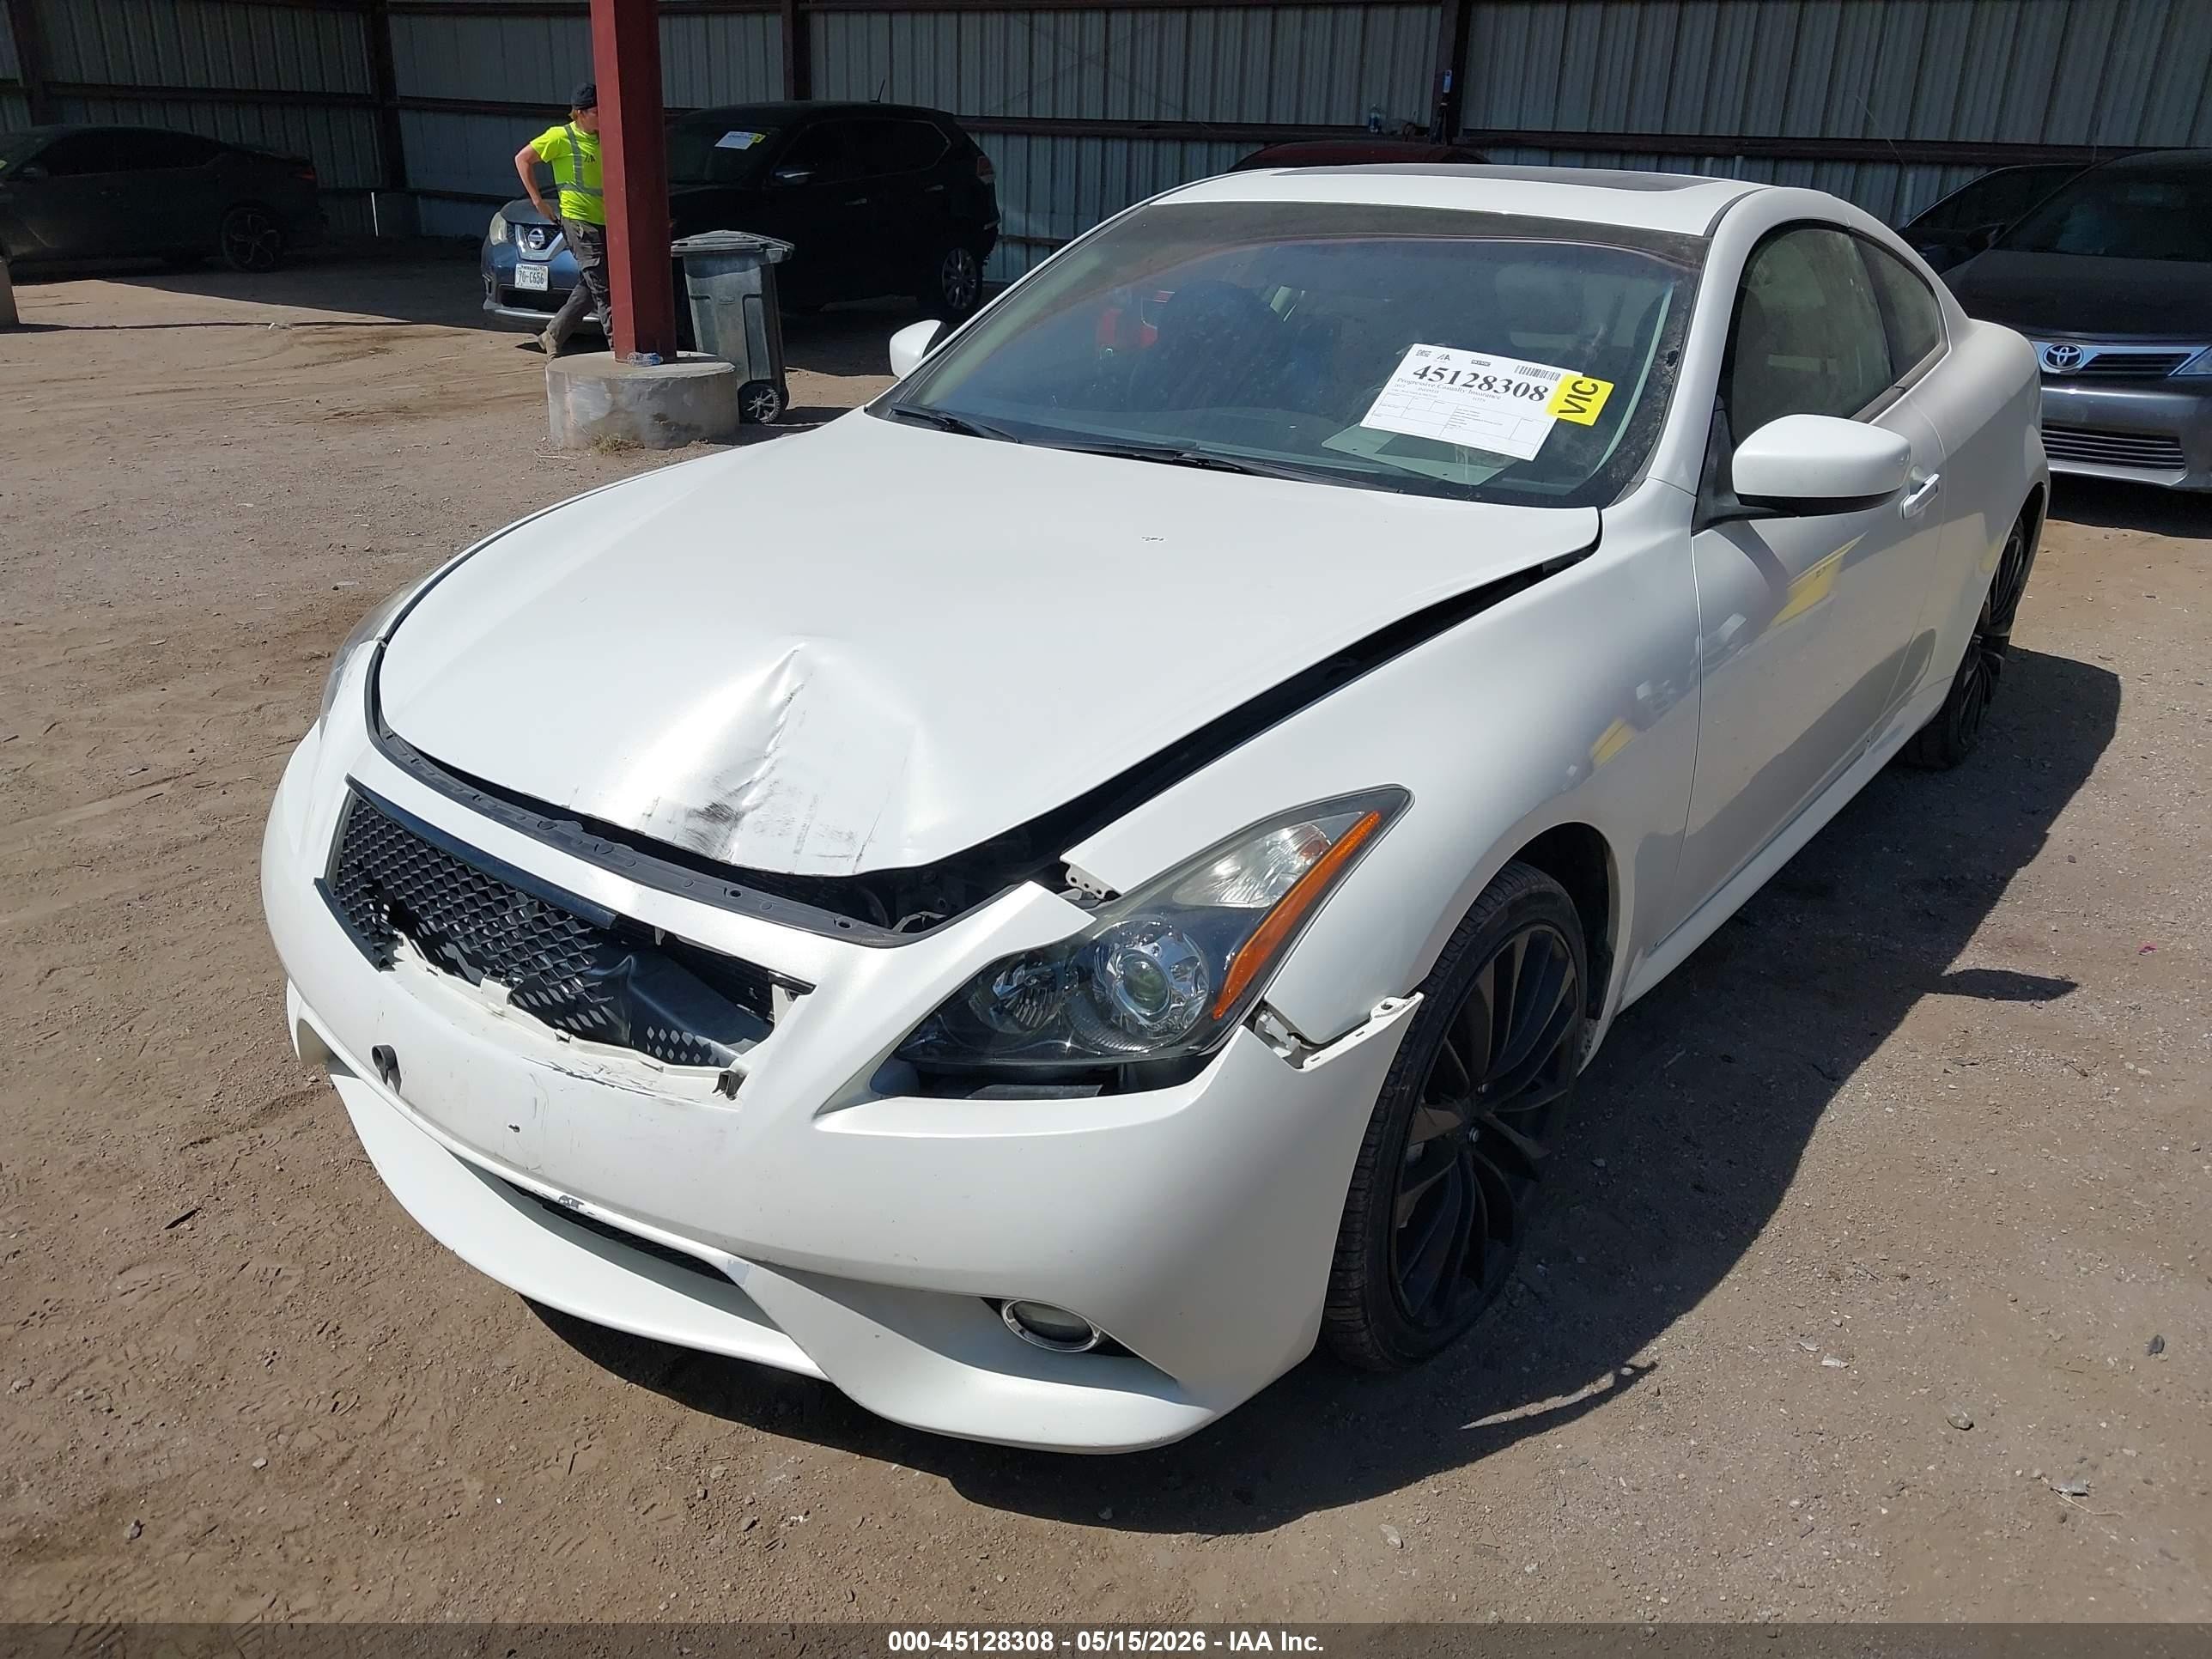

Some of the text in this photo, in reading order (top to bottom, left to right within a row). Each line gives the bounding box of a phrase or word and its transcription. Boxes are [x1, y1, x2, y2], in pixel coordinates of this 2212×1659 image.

[519, 270, 544, 285] 70-C656
[1413, 365, 1548, 402] 45128308
[1558, 380, 1599, 414] VIC
